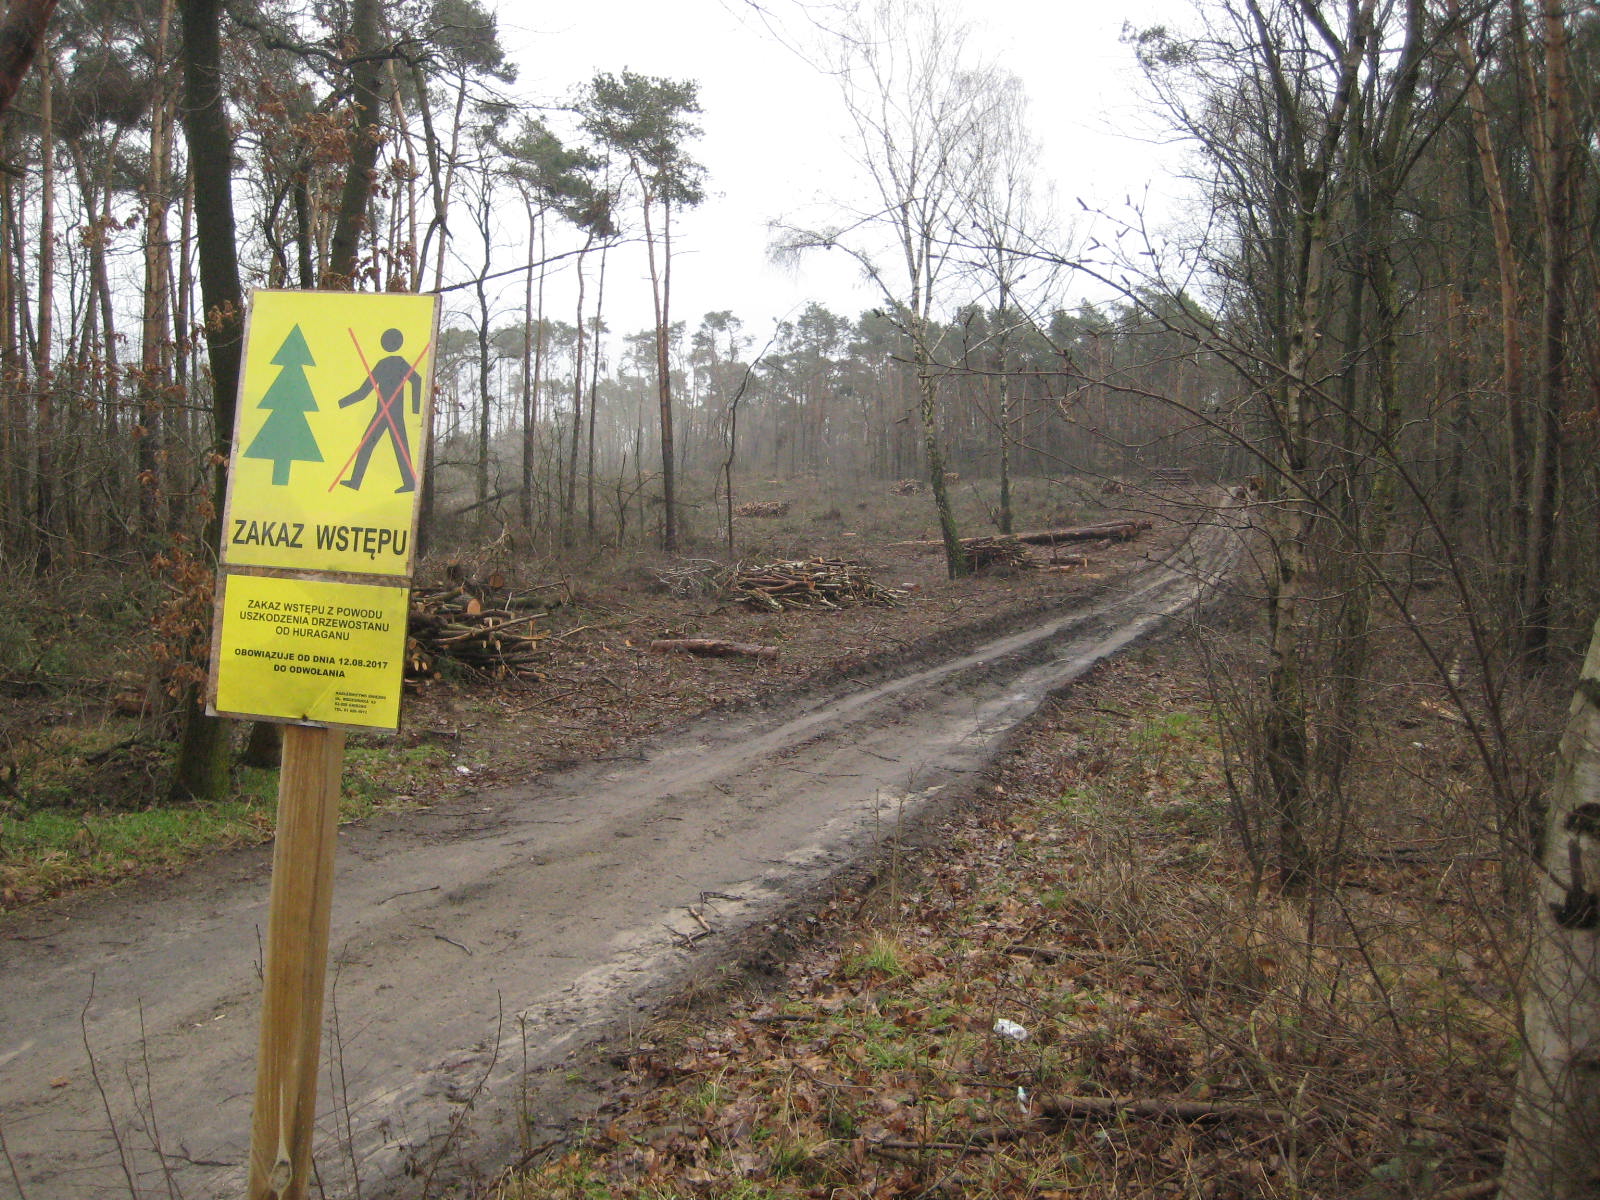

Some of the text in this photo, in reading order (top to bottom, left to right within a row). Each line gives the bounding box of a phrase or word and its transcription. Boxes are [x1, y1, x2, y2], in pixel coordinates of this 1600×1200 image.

[232, 519, 407, 560] ZAKAZ WSTĘPU
[247, 599, 383, 619] ZAKAZ WSTĘPU Z POWODU
[239, 611, 389, 632] USZKODZENIA DRZEWOSTANU
[275, 626, 350, 641] OD HURAGANU
[234, 648, 388, 669] OBOWIĄZUJE OD DNIA 12.08.2017
[273, 664, 345, 678] DO ODWOŁANIA
